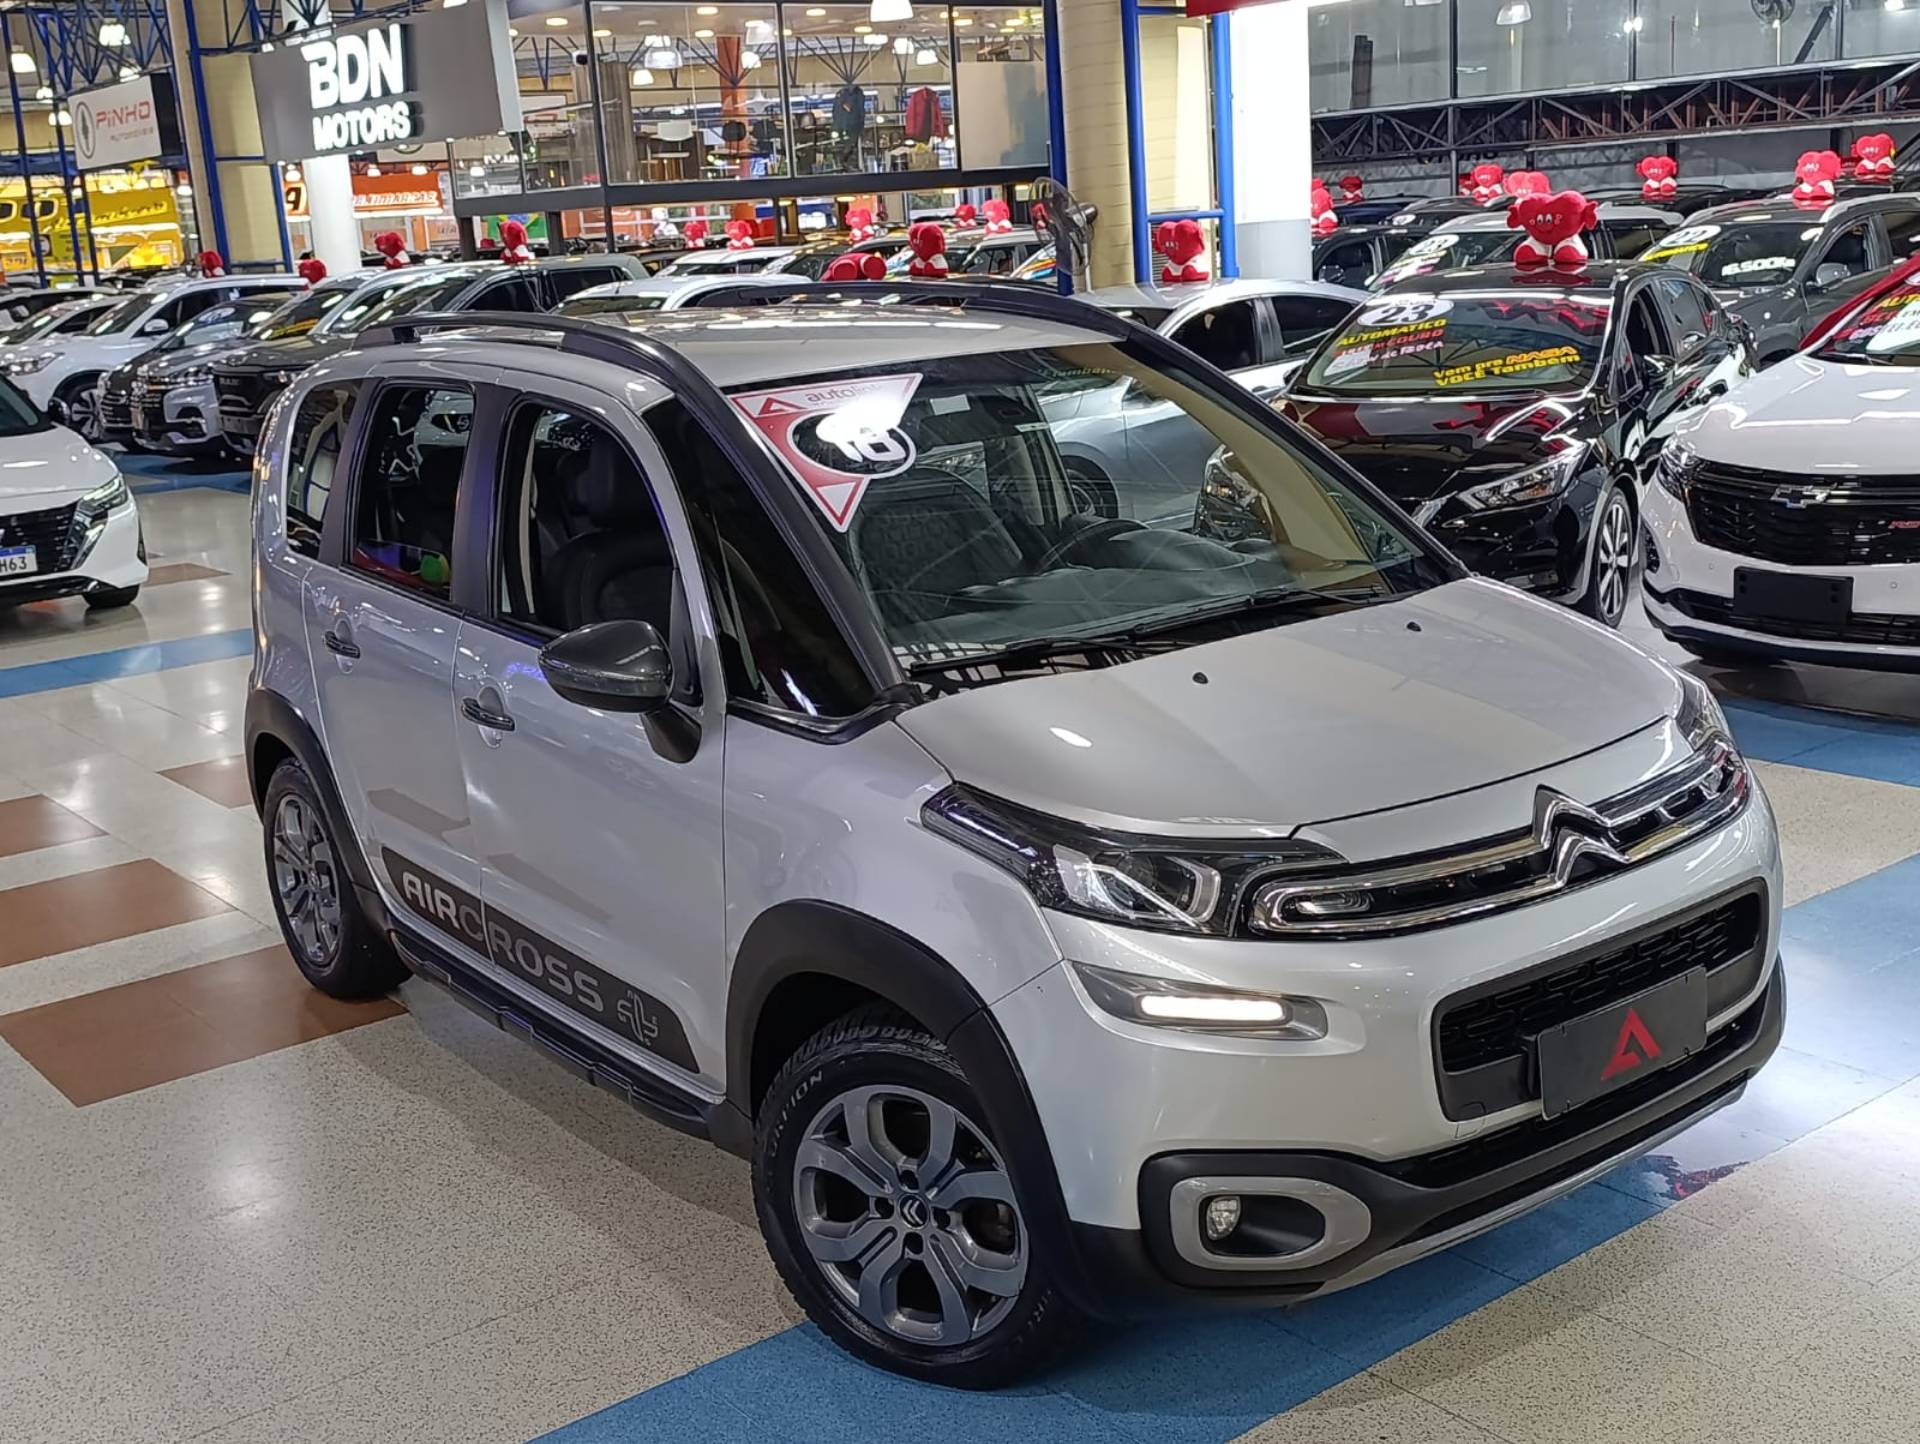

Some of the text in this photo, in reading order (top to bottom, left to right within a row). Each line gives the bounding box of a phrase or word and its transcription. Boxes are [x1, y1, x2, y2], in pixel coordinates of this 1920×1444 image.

[301, 23, 404, 109] BDN
[312, 101, 411, 151] MOTORS
[1370, 303, 1436, 325] 23
[1433, 365, 1472, 379] Vem
[402, 871, 604, 1013] AIRCROSS
